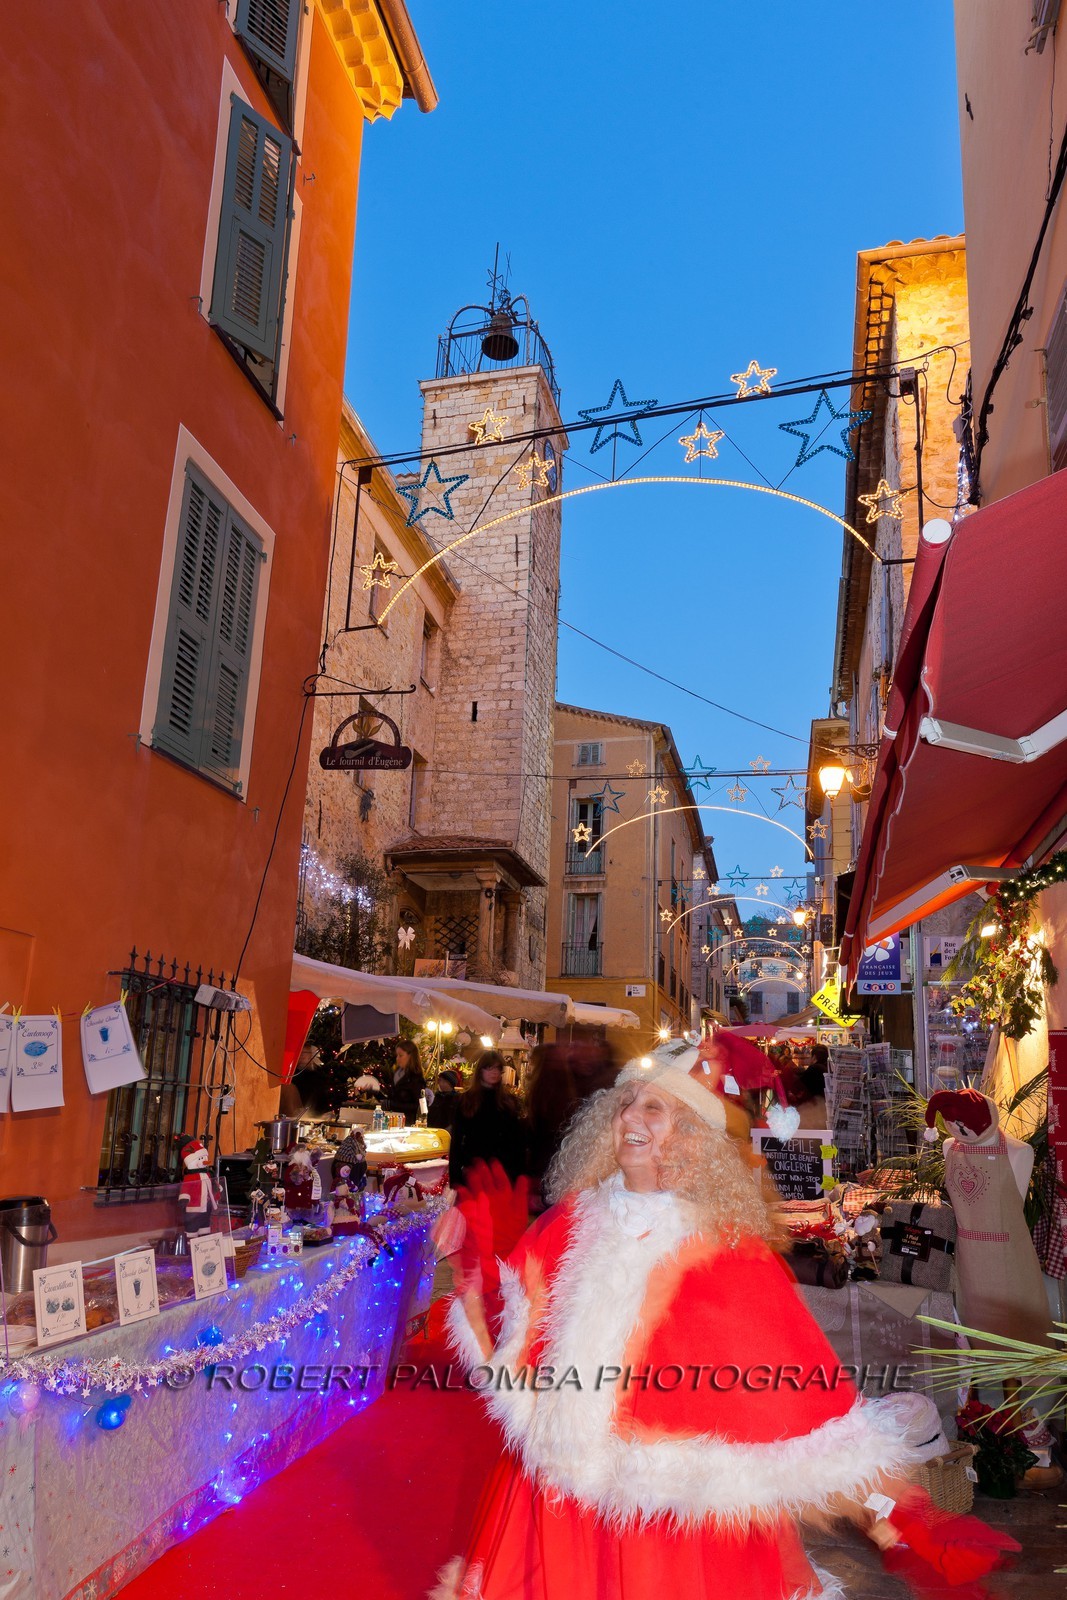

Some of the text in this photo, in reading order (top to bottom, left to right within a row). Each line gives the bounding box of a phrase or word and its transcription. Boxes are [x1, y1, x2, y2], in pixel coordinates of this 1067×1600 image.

[326, 757, 403, 768] Le fournil d'Eugène
[862, 982, 896, 992] LOTO
[816, 993, 850, 1024] PRESE
[766, 1152, 787, 1160] INSTITUT
[790, 1153, 797, 1161] DE
[774, 1161, 813, 1173] ONGLERIE
[763, 1173, 787, 1181] OUVERT
[793, 1184, 803, 1192] AU
[781, 1191, 804, 1199] SAMEDI
